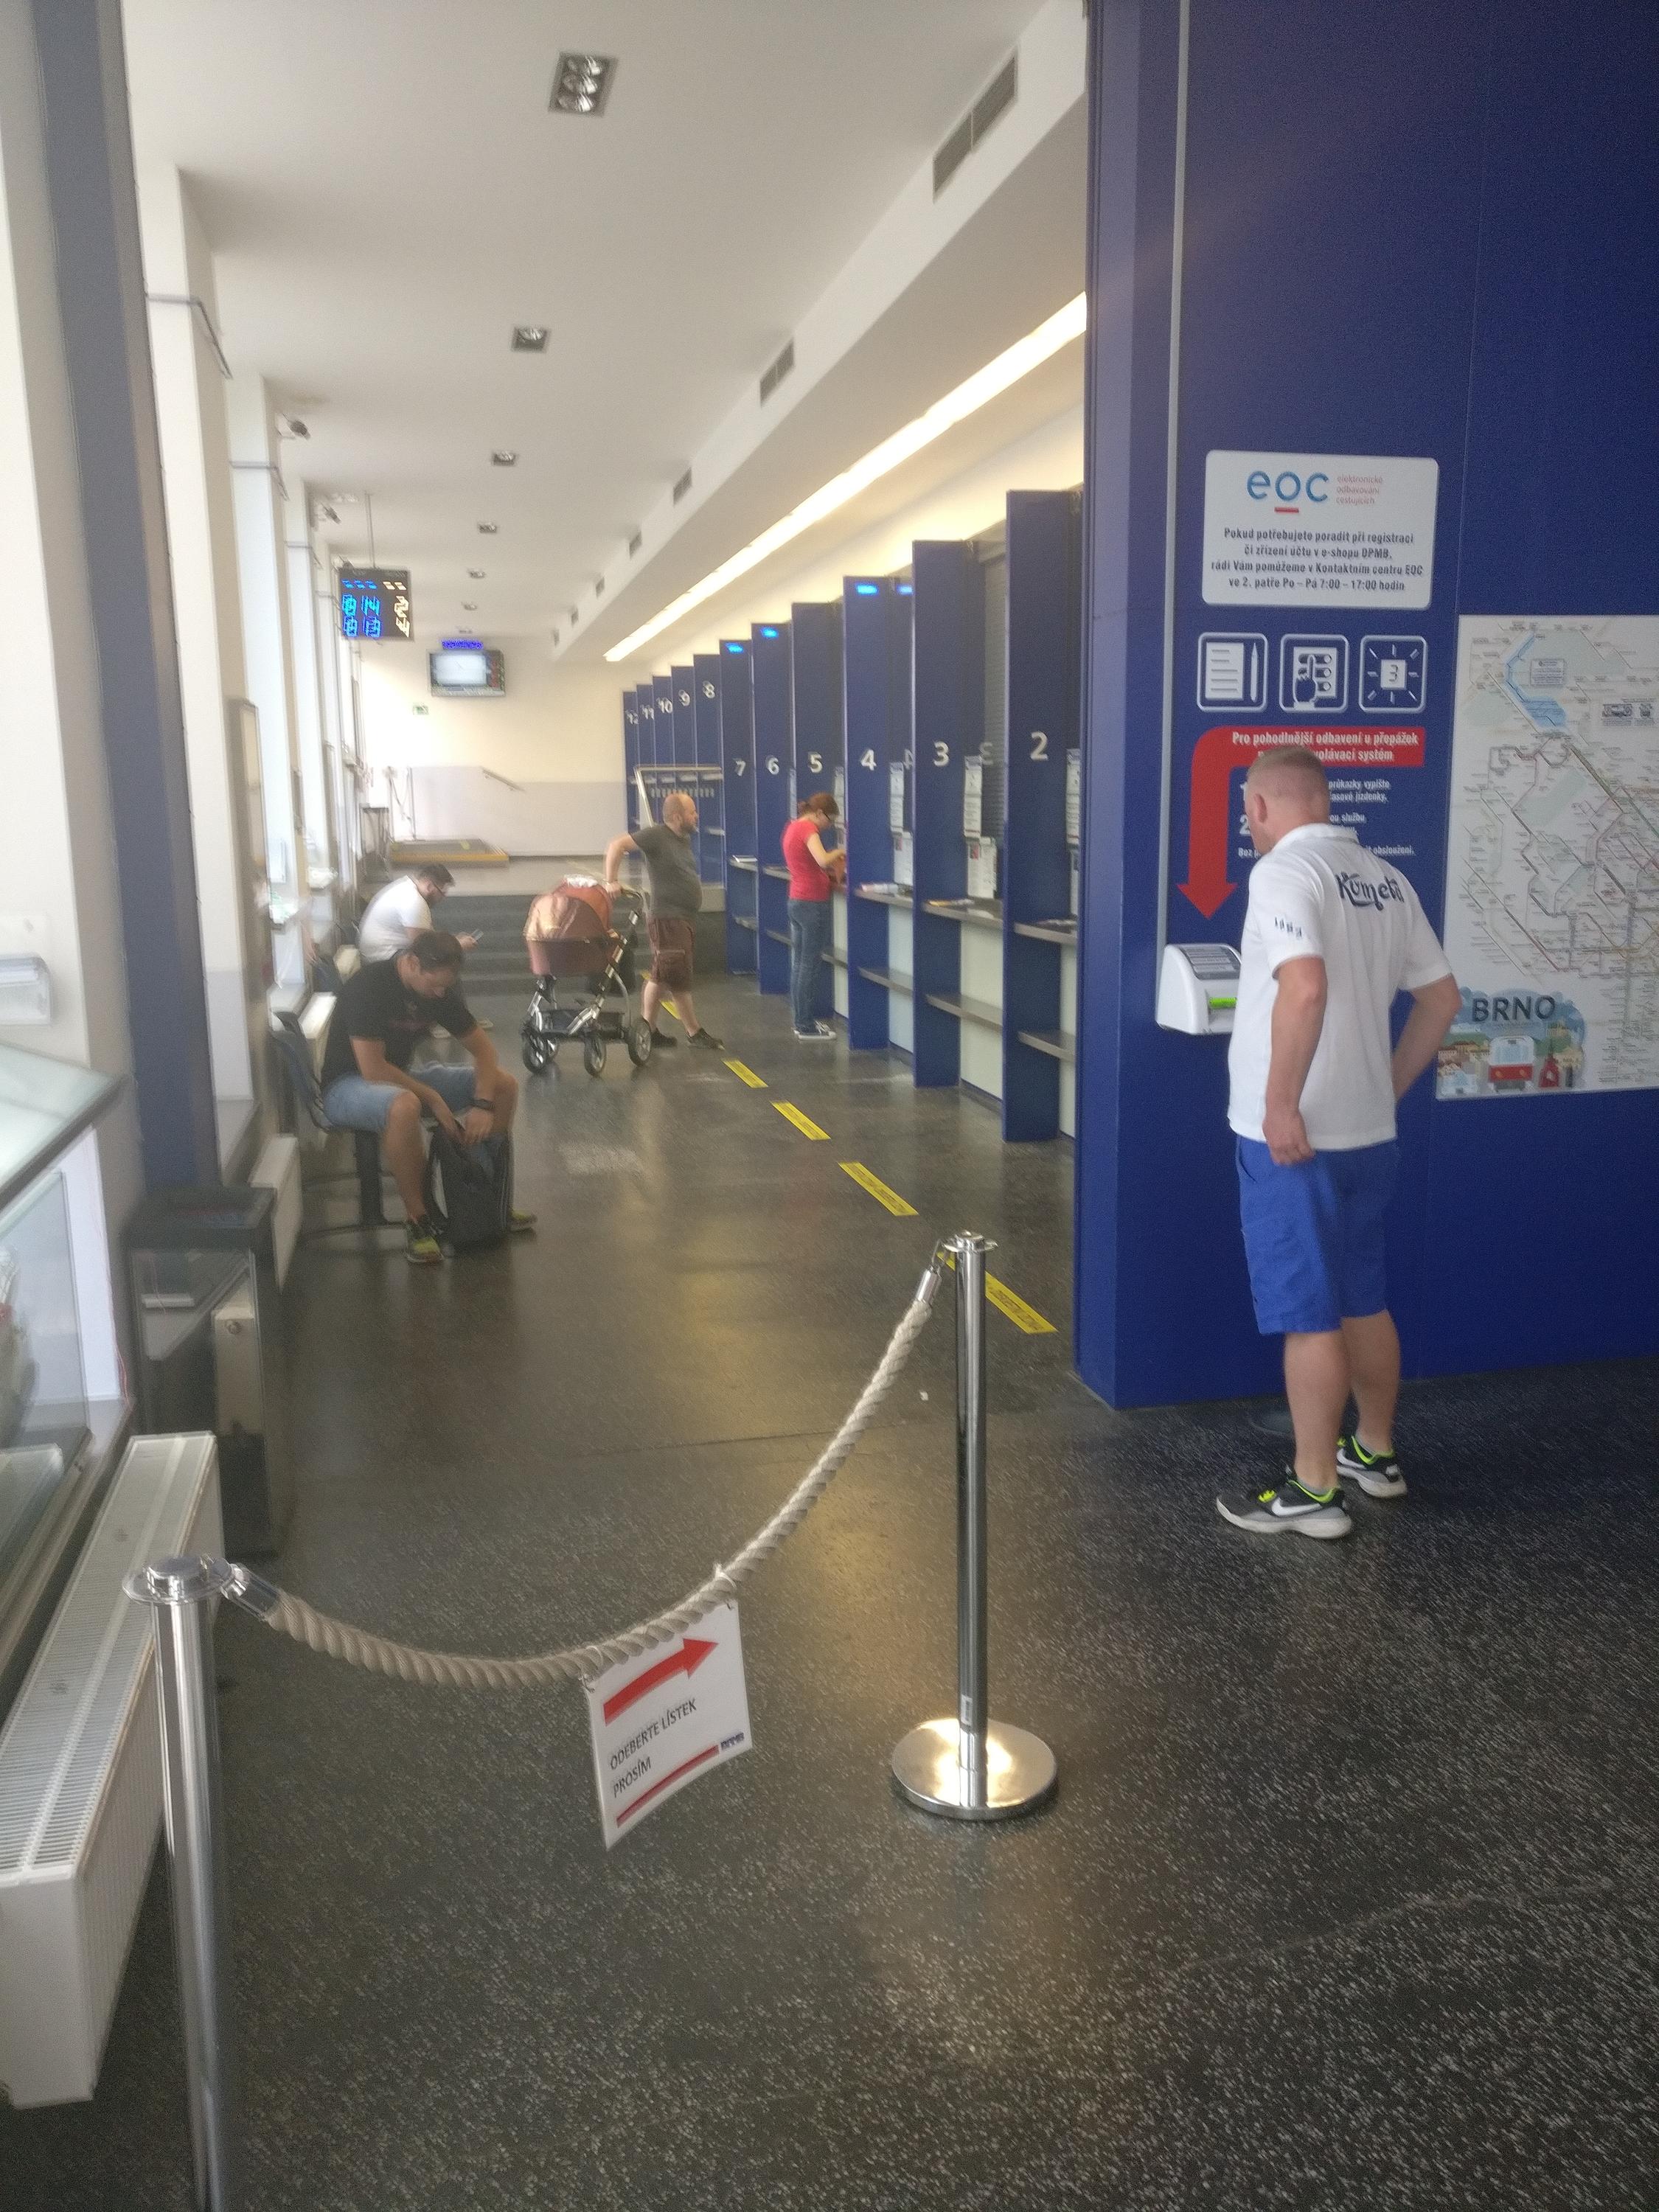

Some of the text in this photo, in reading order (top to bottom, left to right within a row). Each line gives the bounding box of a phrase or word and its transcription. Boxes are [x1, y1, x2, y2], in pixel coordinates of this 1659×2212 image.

[1246, 470, 1329, 503] eoc
[1224, 527, 1254, 539] Pokud
[1256, 529, 1312, 542] potřebujete
[1315, 530, 1350, 543] poradit
[1367, 532, 1413, 545] registraci
[1314, 549, 1318, 557] v
[1321, 547, 1359, 560] e-shopu
[1308, 564, 1313, 573] v
[1372, 564, 1402, 575] centru
[1229, 578, 1239, 587] ve
[1255, 577, 1280, 589] patře
[1282, 577, 1295, 588] Po
[1320, 578, 1340, 589] 7:00
[1351, 580, 1377, 591] 17:00
[1379, 580, 1405, 591] hodin
[678, 690, 690, 706] 9
[703, 680, 715, 699] 8
[656, 697, 672, 713] 10
[1030, 731, 1048, 760] 2
[1232, 731, 1251, 745] Pro
[1253, 731, 1313, 747] pohodlnější
[1316, 731, 1363, 745] odbavení
[1364, 735, 1371, 744] u
[808, 751, 822, 773] 5
[860, 748, 877, 771] 4
[933, 741, 950, 766] 3
[1357, 748, 1394, 764] systém
[734, 758, 746, 776] 7
[765, 754, 779, 775] 6
[1238, 847, 1253, 858] Bez
[1472, 995, 1556, 1022] BRNO
[610, 1697, 697, 1771] ODEBERTE LÍSTEK
[613, 1756, 652, 1798] PROSÍM
